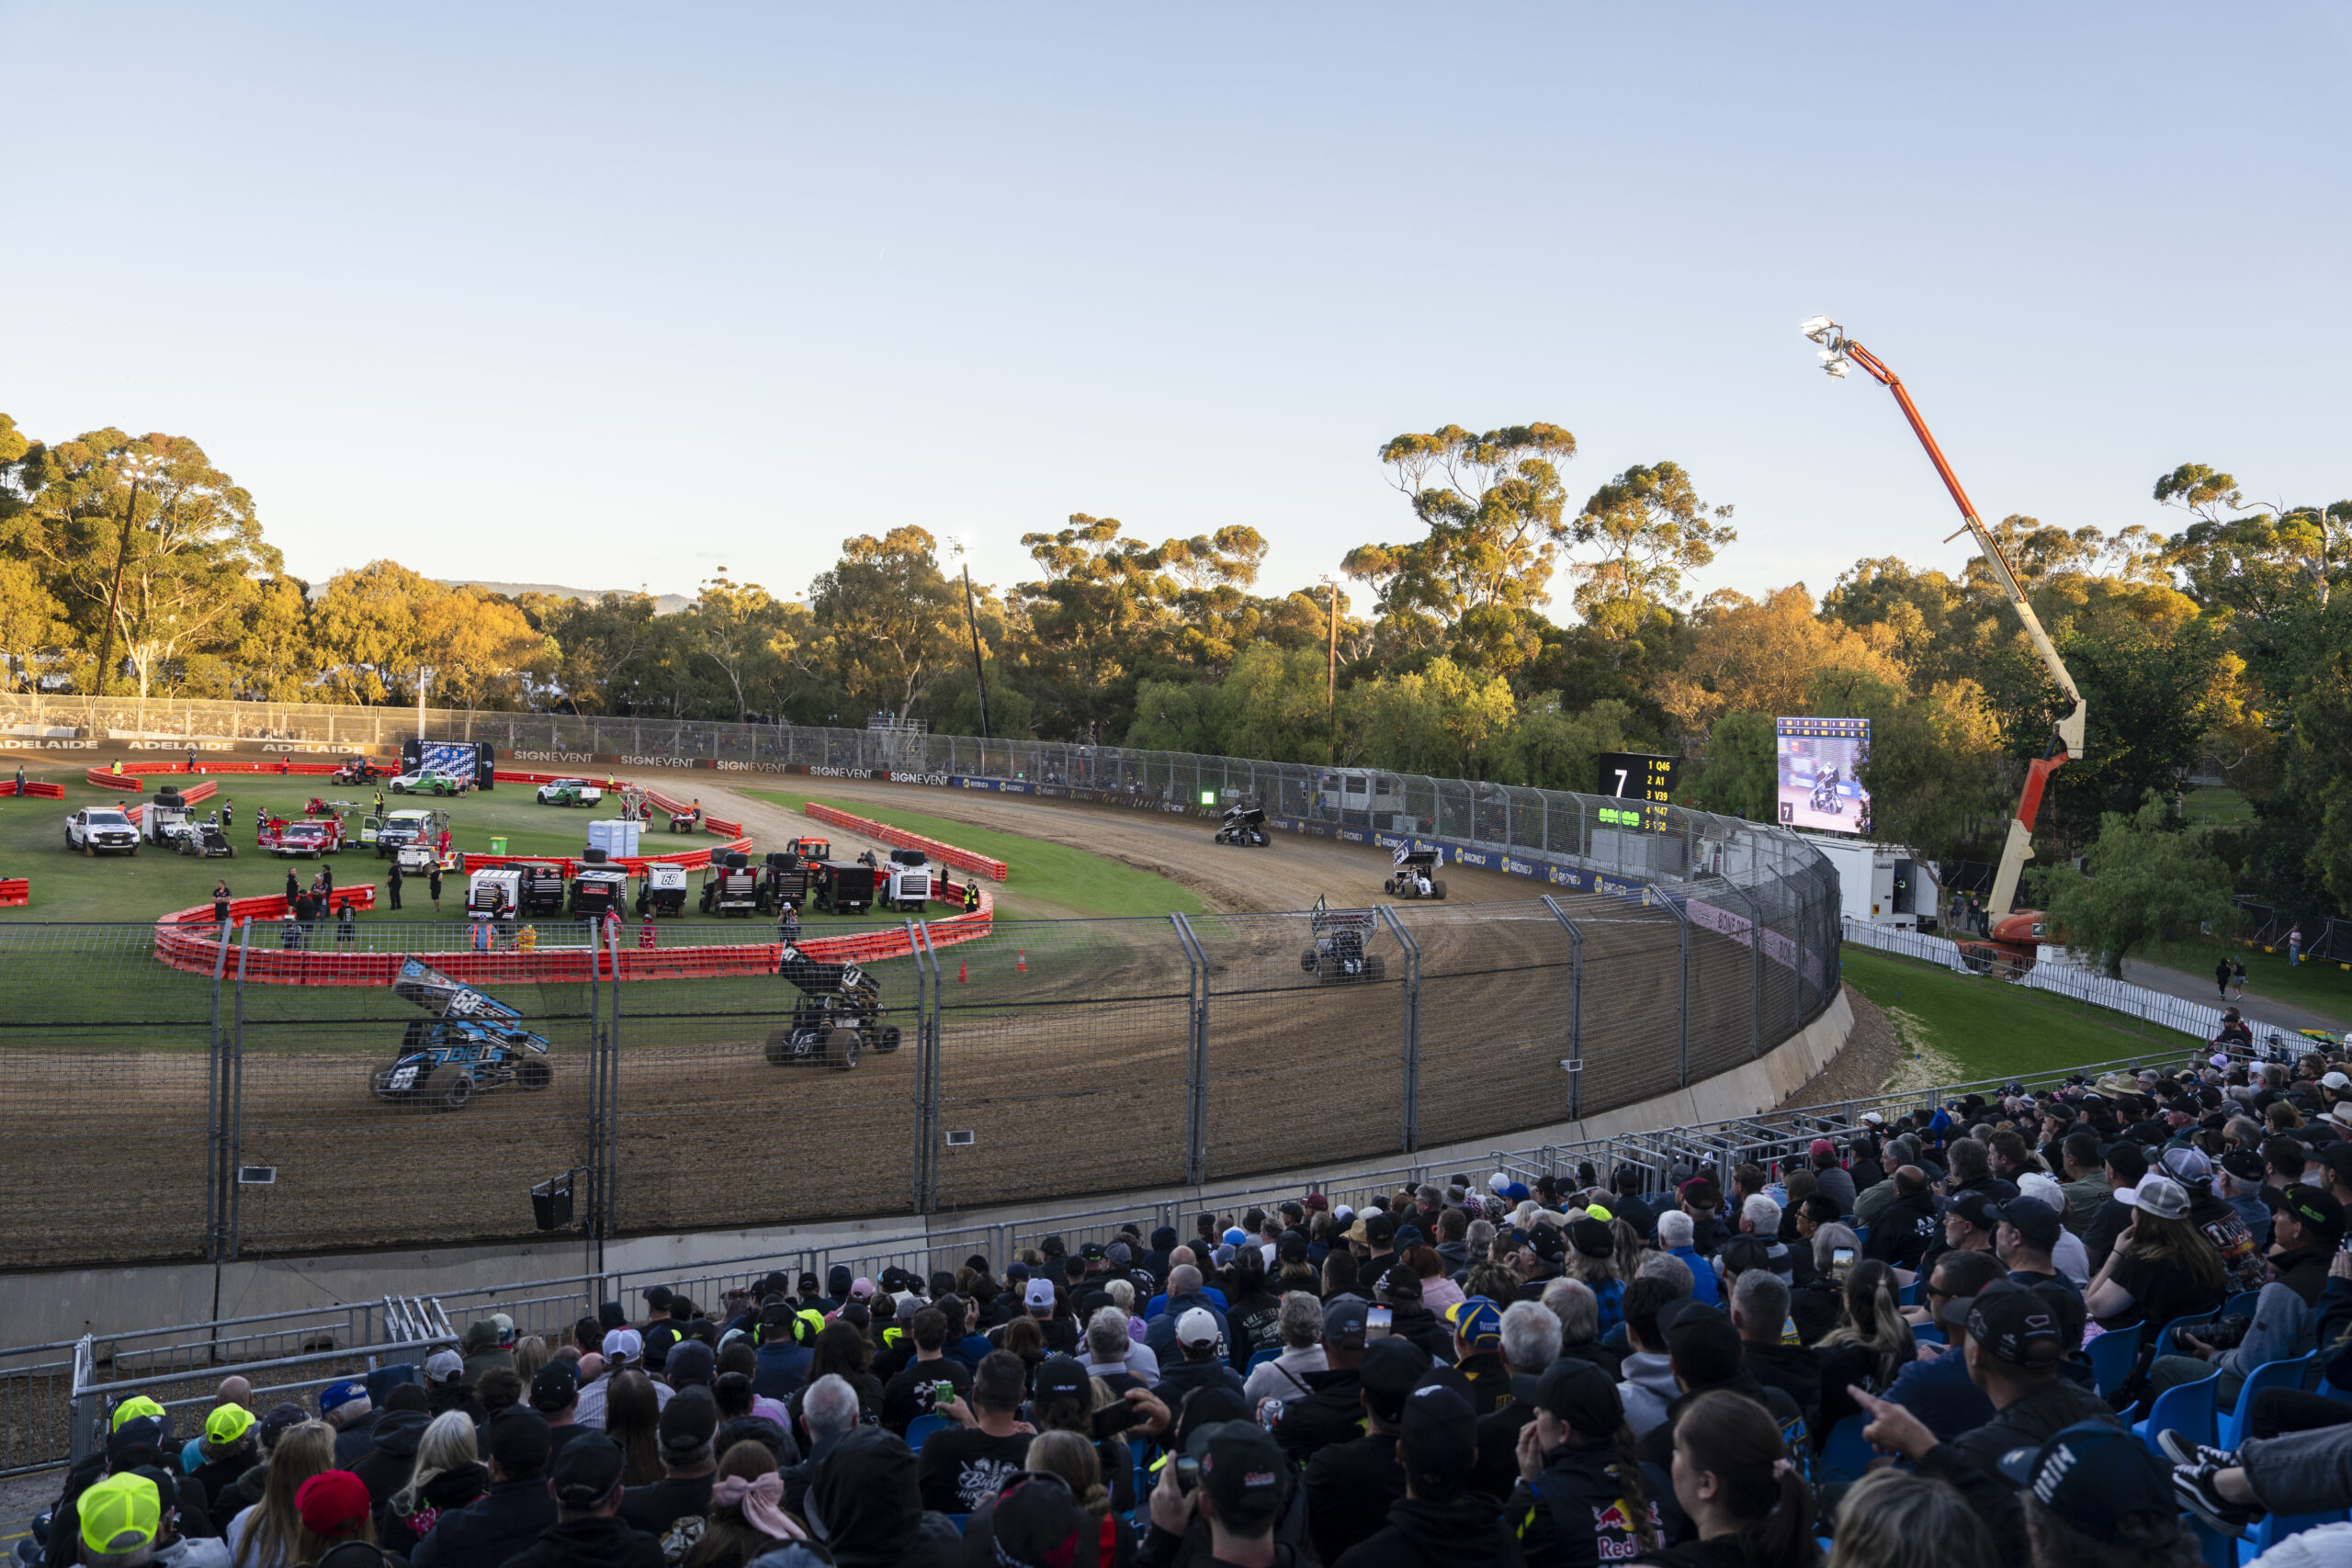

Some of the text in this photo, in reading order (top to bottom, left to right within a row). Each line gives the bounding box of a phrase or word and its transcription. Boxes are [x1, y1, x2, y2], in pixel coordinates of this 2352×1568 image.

[128, 740, 234, 751] ADELAIDE
[262, 742, 366, 754] ADELAIDE
[514, 750, 593, 763] SIGNEVENT
[620, 754, 695, 768] SIGNEVENT
[717, 760, 787, 773] SIGNEVENT
[809, 765, 873, 779] SIGNEVENT
[1648, 761, 1670, 772] 1 Q46
[890, 772, 949, 786] SIGNEVENT
[1614, 769, 1627, 798] 7
[1647, 775, 1665, 785] 2 A1
[1646, 791, 1668, 801] 3 V39
[1783, 807, 1789, 818] 7
[662, 874, 678, 885] 68
[451, 988, 482, 1014] 68
[1599, 1533, 1635, 1559] Red
